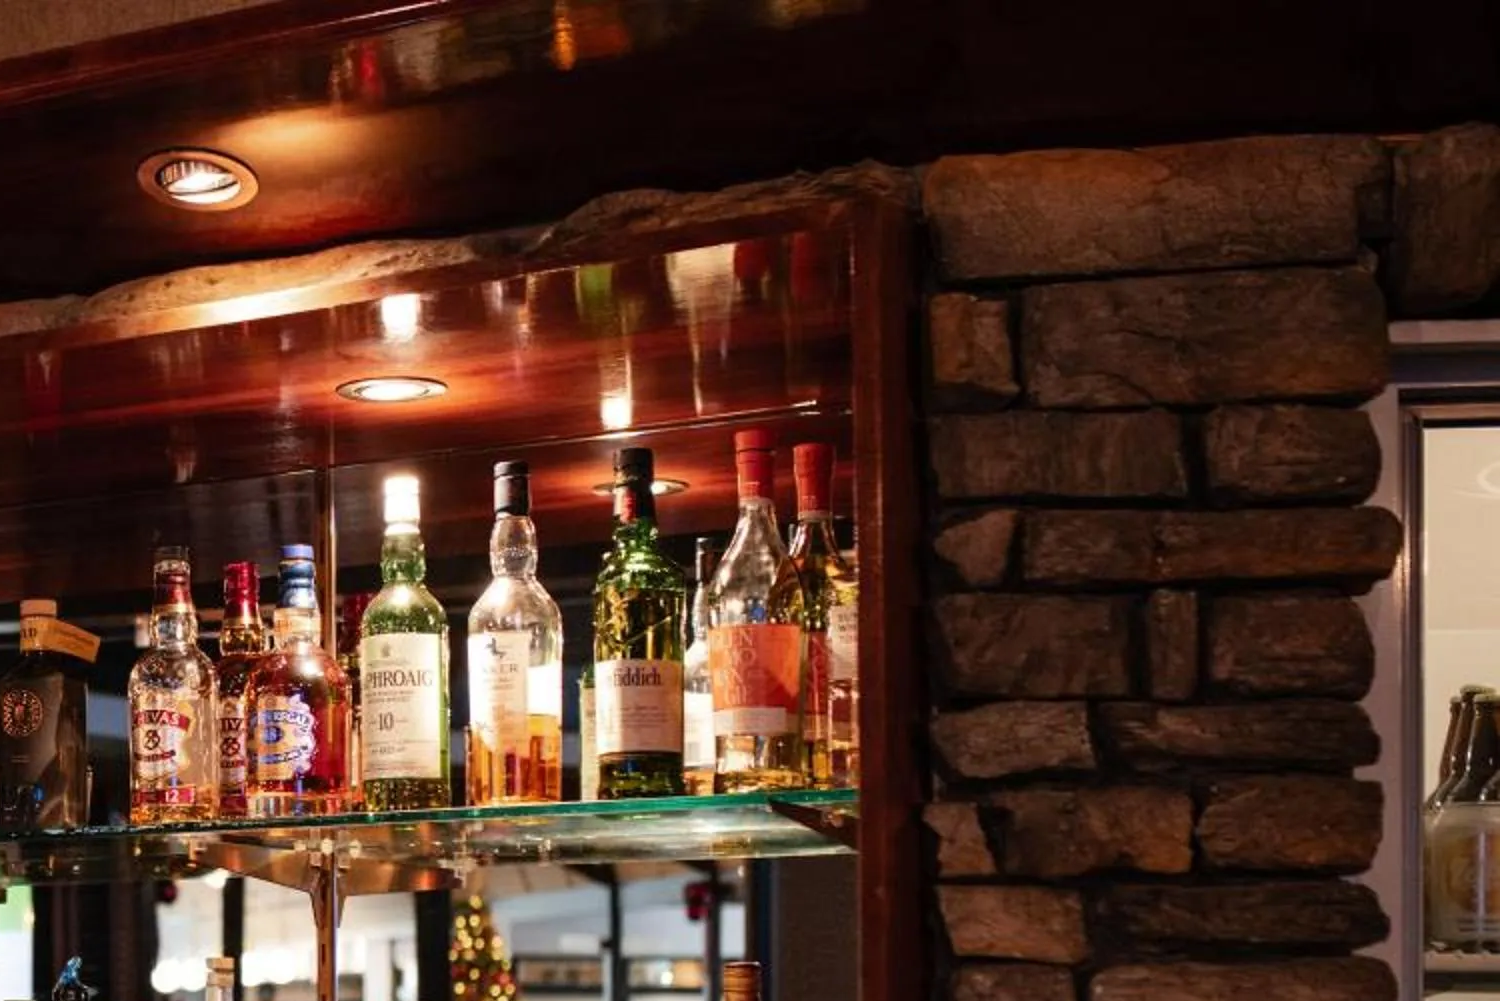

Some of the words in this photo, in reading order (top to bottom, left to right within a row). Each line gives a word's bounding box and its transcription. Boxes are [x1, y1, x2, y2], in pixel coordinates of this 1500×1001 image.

[365, 670, 433, 689] PHROAIG
[379, 712, 394, 731] 10
[165, 789, 179, 803] 12
